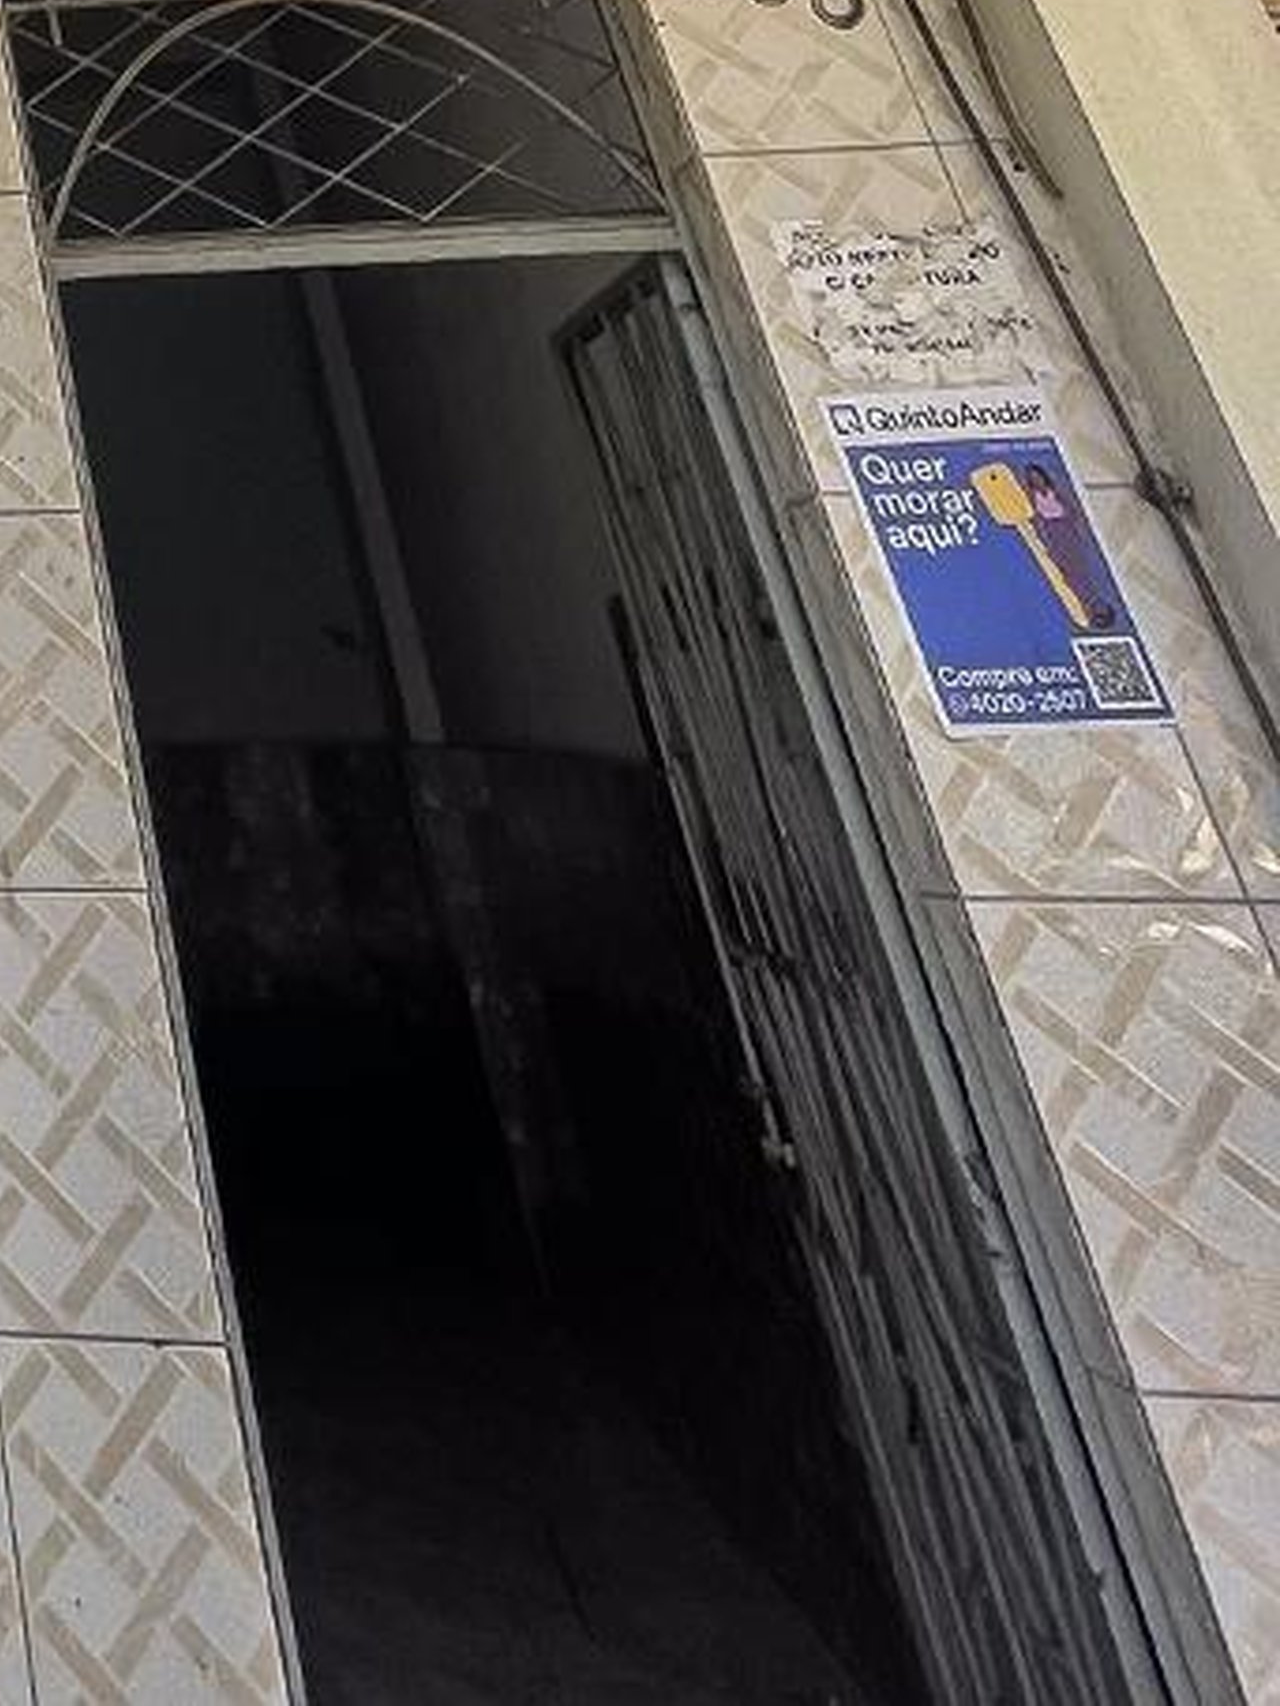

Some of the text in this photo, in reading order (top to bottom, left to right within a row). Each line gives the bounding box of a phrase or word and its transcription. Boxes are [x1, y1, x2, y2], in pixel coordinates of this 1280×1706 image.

[865, 400, 1042, 432] QuintoAndar
[860, 453, 947, 485] Quer
[873, 488, 975, 517] morar
[886, 513, 980, 557] aqui?
